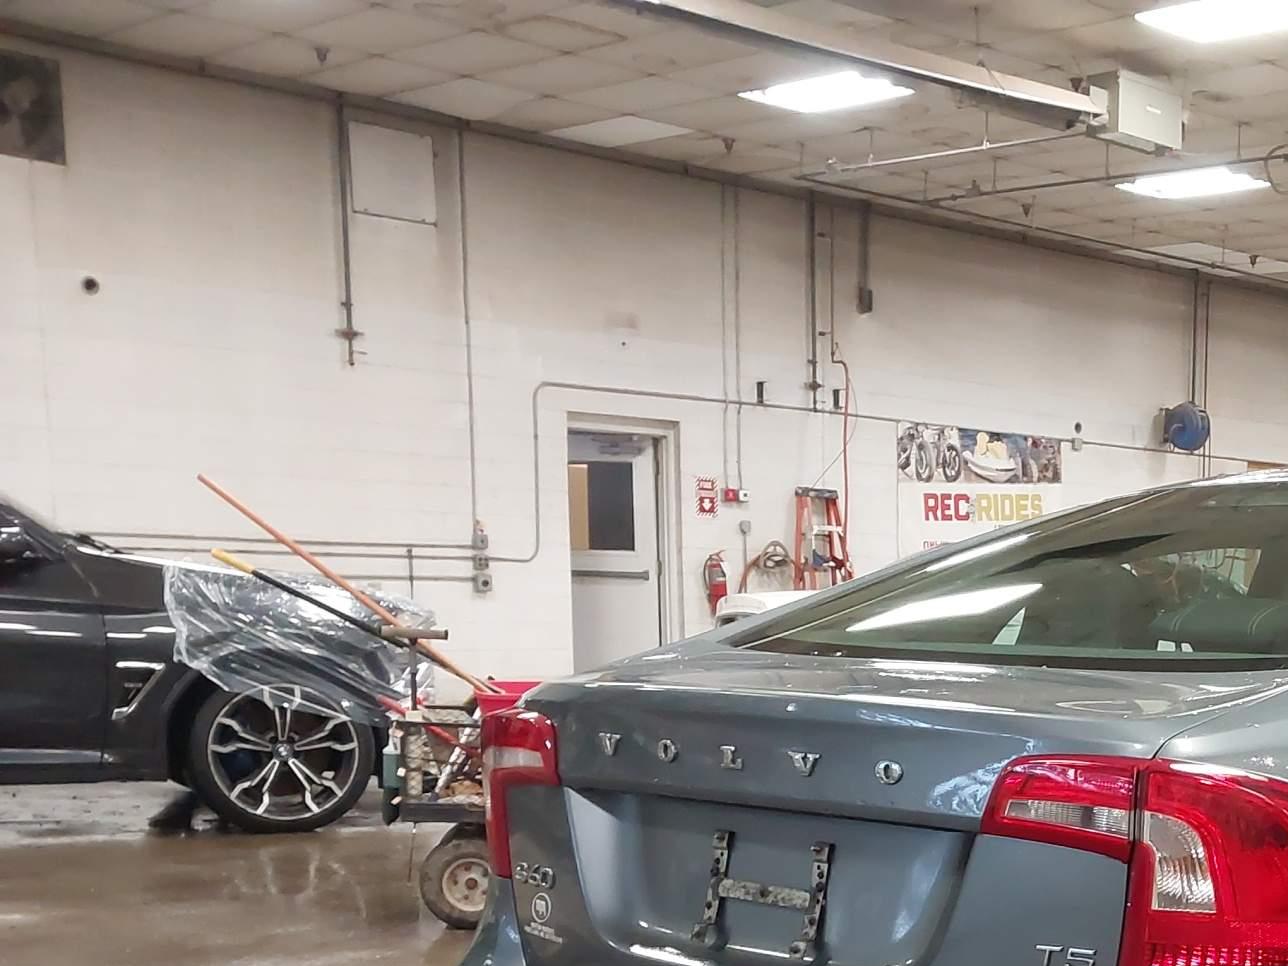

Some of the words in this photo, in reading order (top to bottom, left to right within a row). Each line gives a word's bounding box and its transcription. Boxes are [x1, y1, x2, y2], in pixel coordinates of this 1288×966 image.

[923, 493, 970, 521] REC
[975, 493, 1043, 521] RIDES
[599, 732, 904, 785] VOLVO
[514, 862, 554, 888] S60
